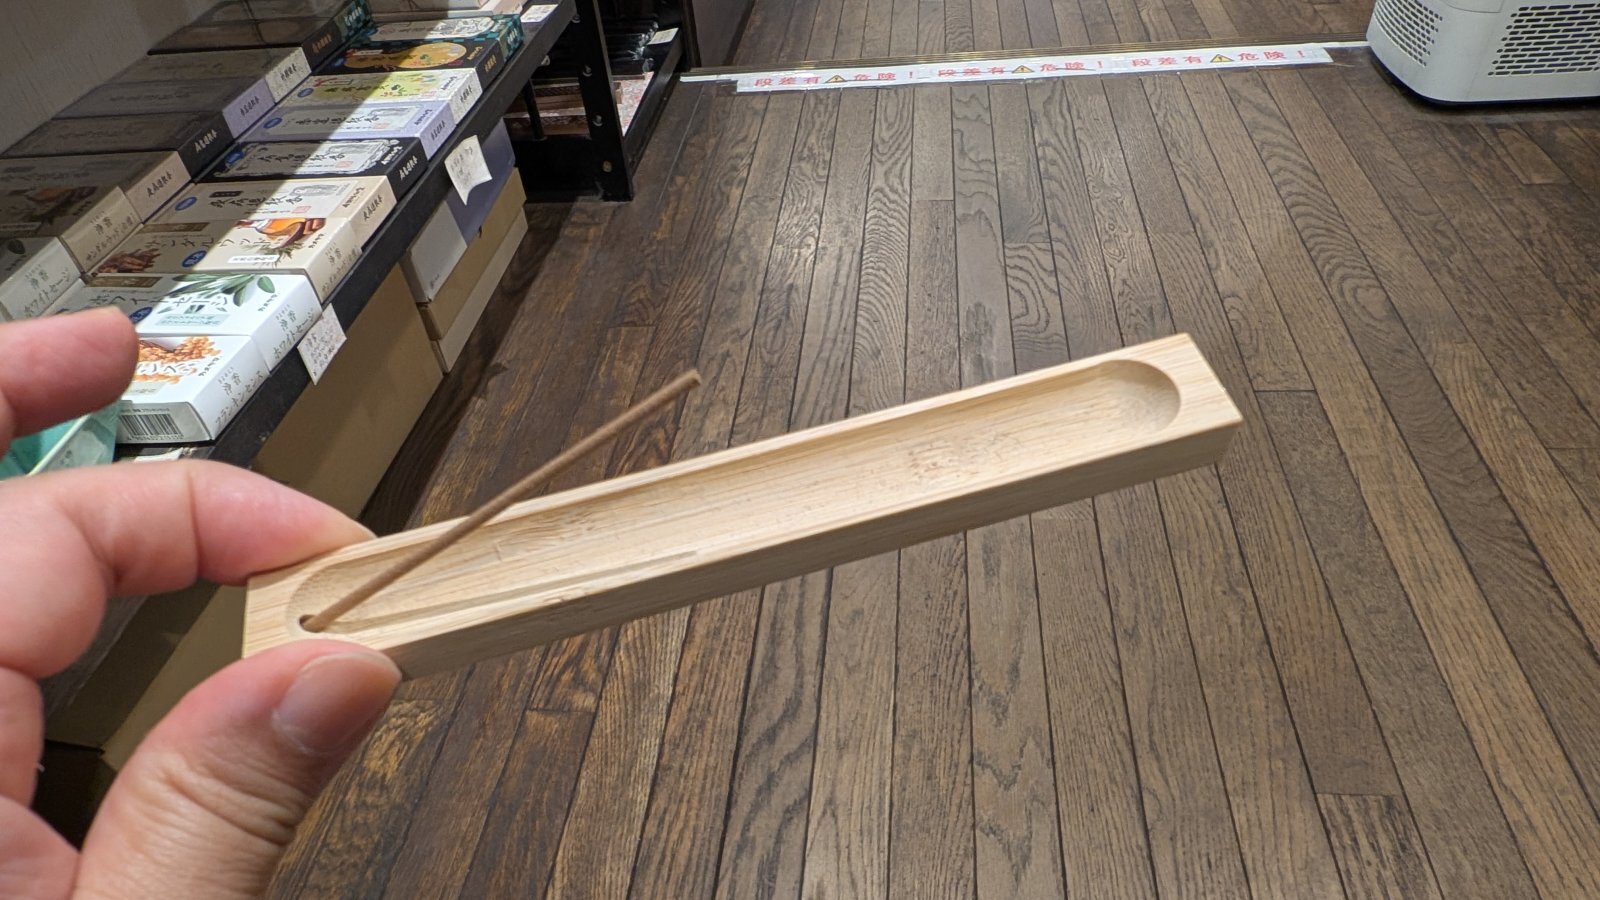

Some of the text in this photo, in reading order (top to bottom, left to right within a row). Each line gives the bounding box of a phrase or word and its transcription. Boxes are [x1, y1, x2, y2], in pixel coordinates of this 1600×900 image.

[1132, 55, 1202, 67] 段差有
[938, 66, 1006, 77] 段差有
[754, 76, 822, 87] 段差有
[90, 294, 230, 306] ホワイトセージ
[273, 308, 315, 360] ホワイトセージ
[215, 370, 264, 426] フランキンセンス
